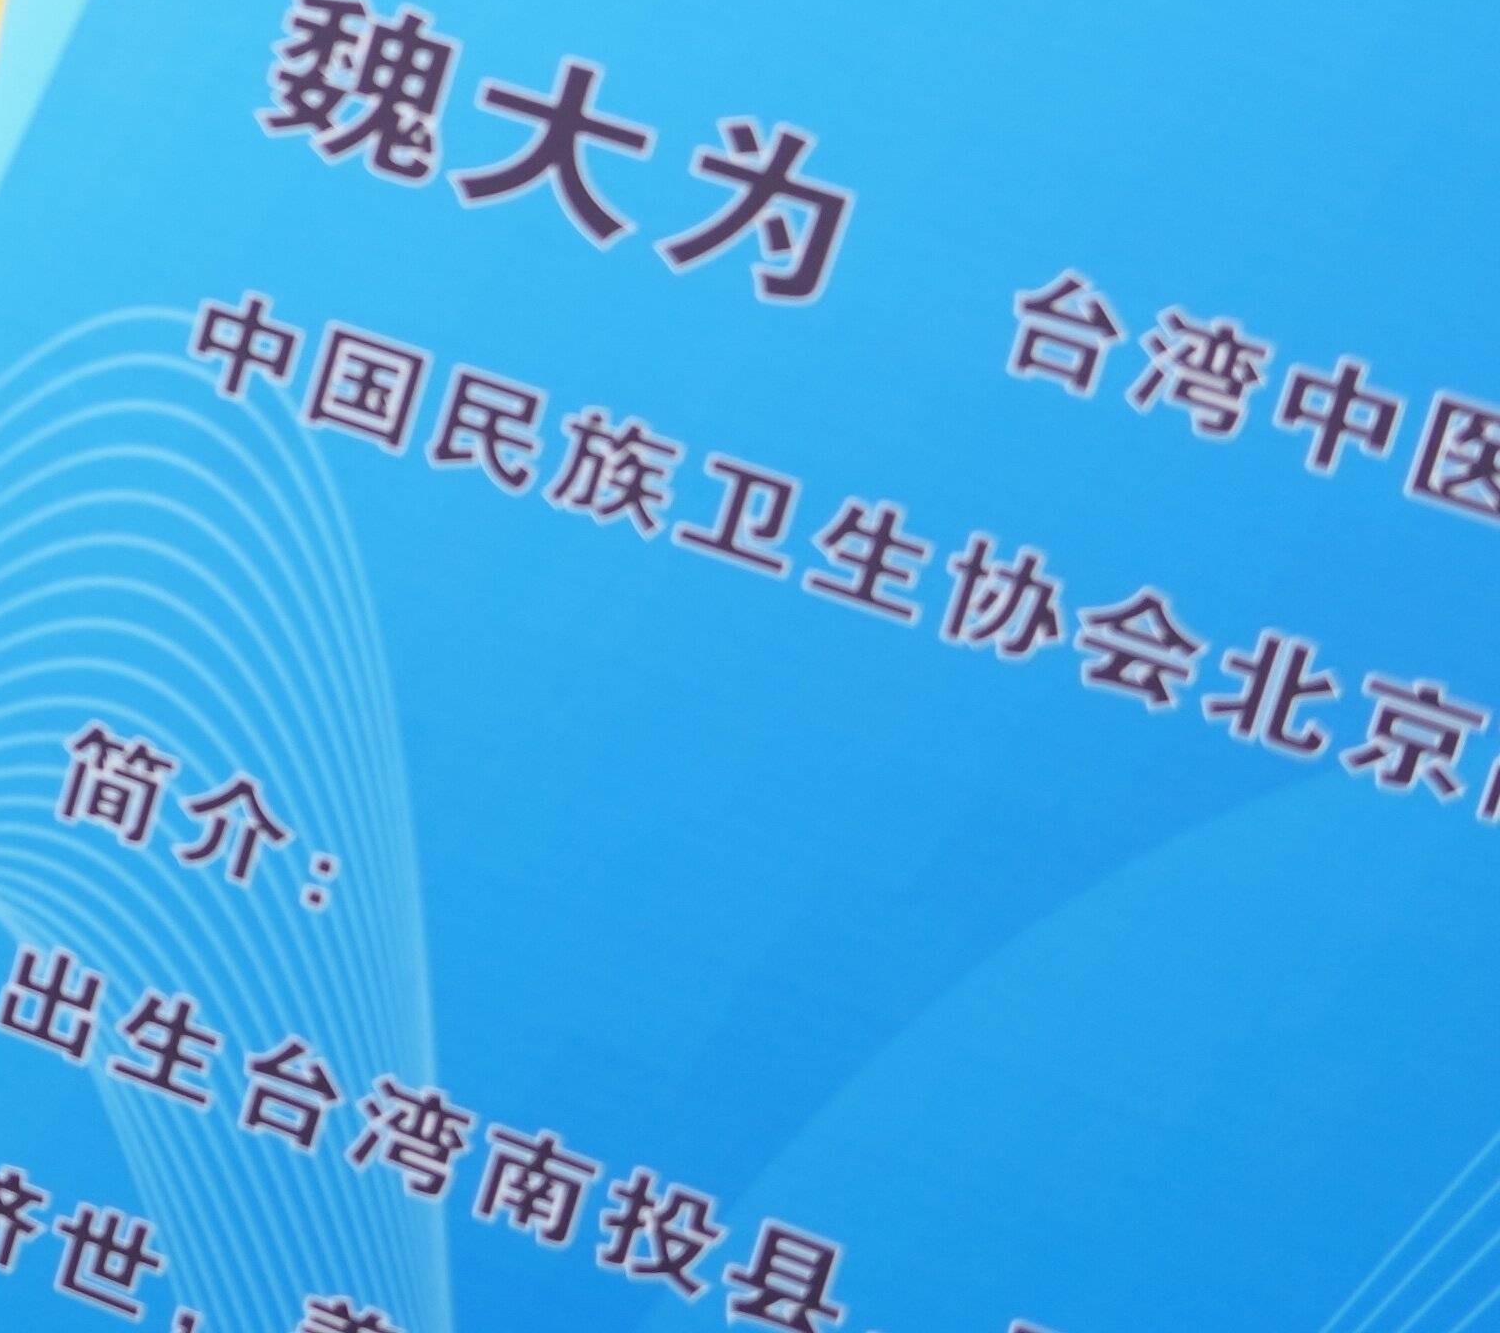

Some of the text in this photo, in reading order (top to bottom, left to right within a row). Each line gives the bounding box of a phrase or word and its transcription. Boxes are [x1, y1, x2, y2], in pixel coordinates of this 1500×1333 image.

[1003, 271, 1500, 522] 台湾中医
[190, 292, 1500, 821] 中国民族卫生协会北京
[56, 721, 337, 908] 简介：
